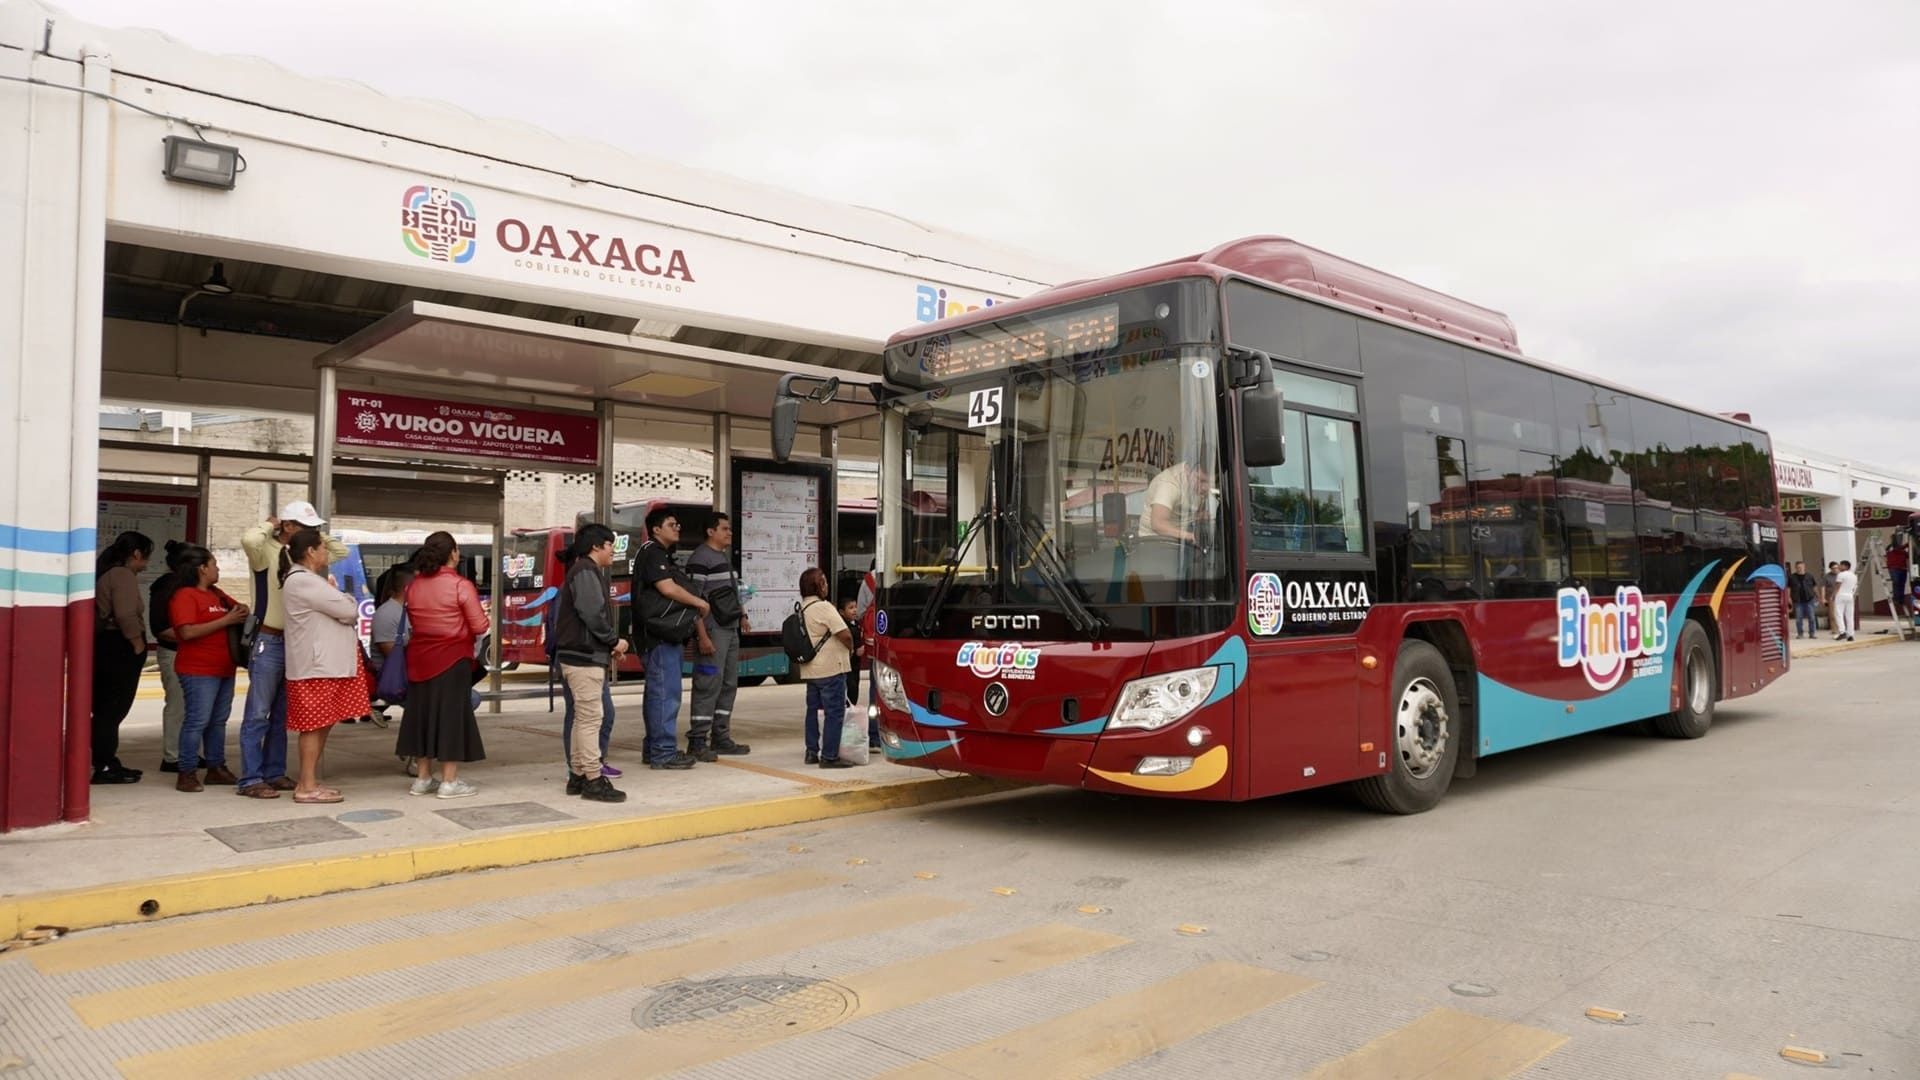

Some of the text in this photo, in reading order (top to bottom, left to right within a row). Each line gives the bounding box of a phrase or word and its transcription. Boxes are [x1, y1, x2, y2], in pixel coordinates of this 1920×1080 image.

[496, 218, 696, 283] OAXACA
[515, 259, 682, 293] GOBIERNO DEL ESTADO
[351, 397, 382, 409] RT-01
[970, 389, 1000, 424] 45
[380, 412, 565, 446] YUROO VIGUERA
[404, 433, 422, 441] CASA
[423, 435, 450, 443] GRANDE
[451, 437, 478, 446] VIGUERA
[1285, 580, 1371, 609] OAXACA
[971, 614, 1040, 630] FOTON
[1291, 610, 1367, 622] GOBIERNO DEL ESTADO
